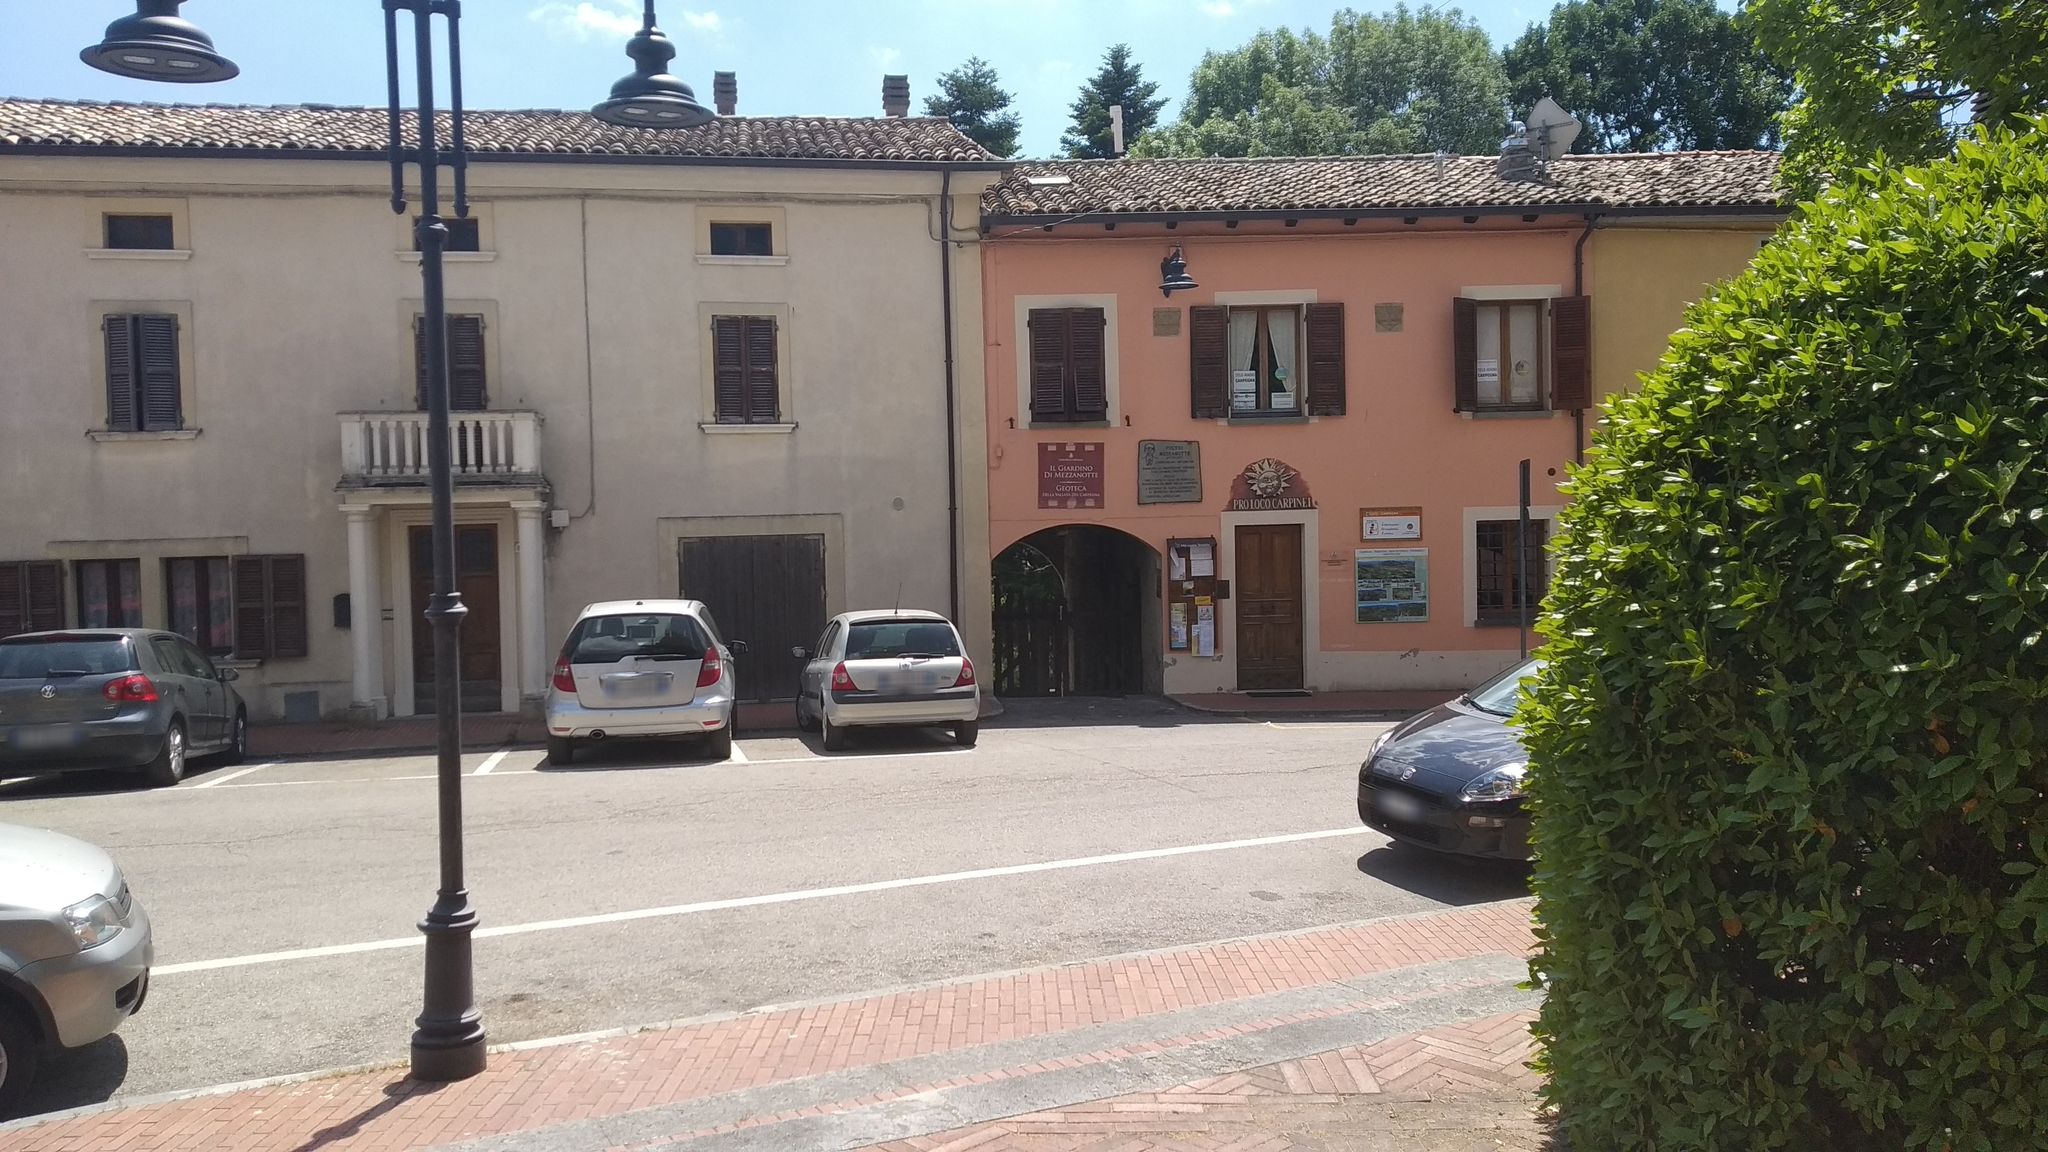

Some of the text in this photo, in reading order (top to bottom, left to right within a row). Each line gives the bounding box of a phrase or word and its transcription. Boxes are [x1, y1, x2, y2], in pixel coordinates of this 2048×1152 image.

[1057, 464, 1094, 472] GIARDINO
[1054, 471, 1098, 479] MEZZANOTTE
[1055, 484, 1087, 492] GEOTECA
[1232, 498, 1249, 510] PRO
